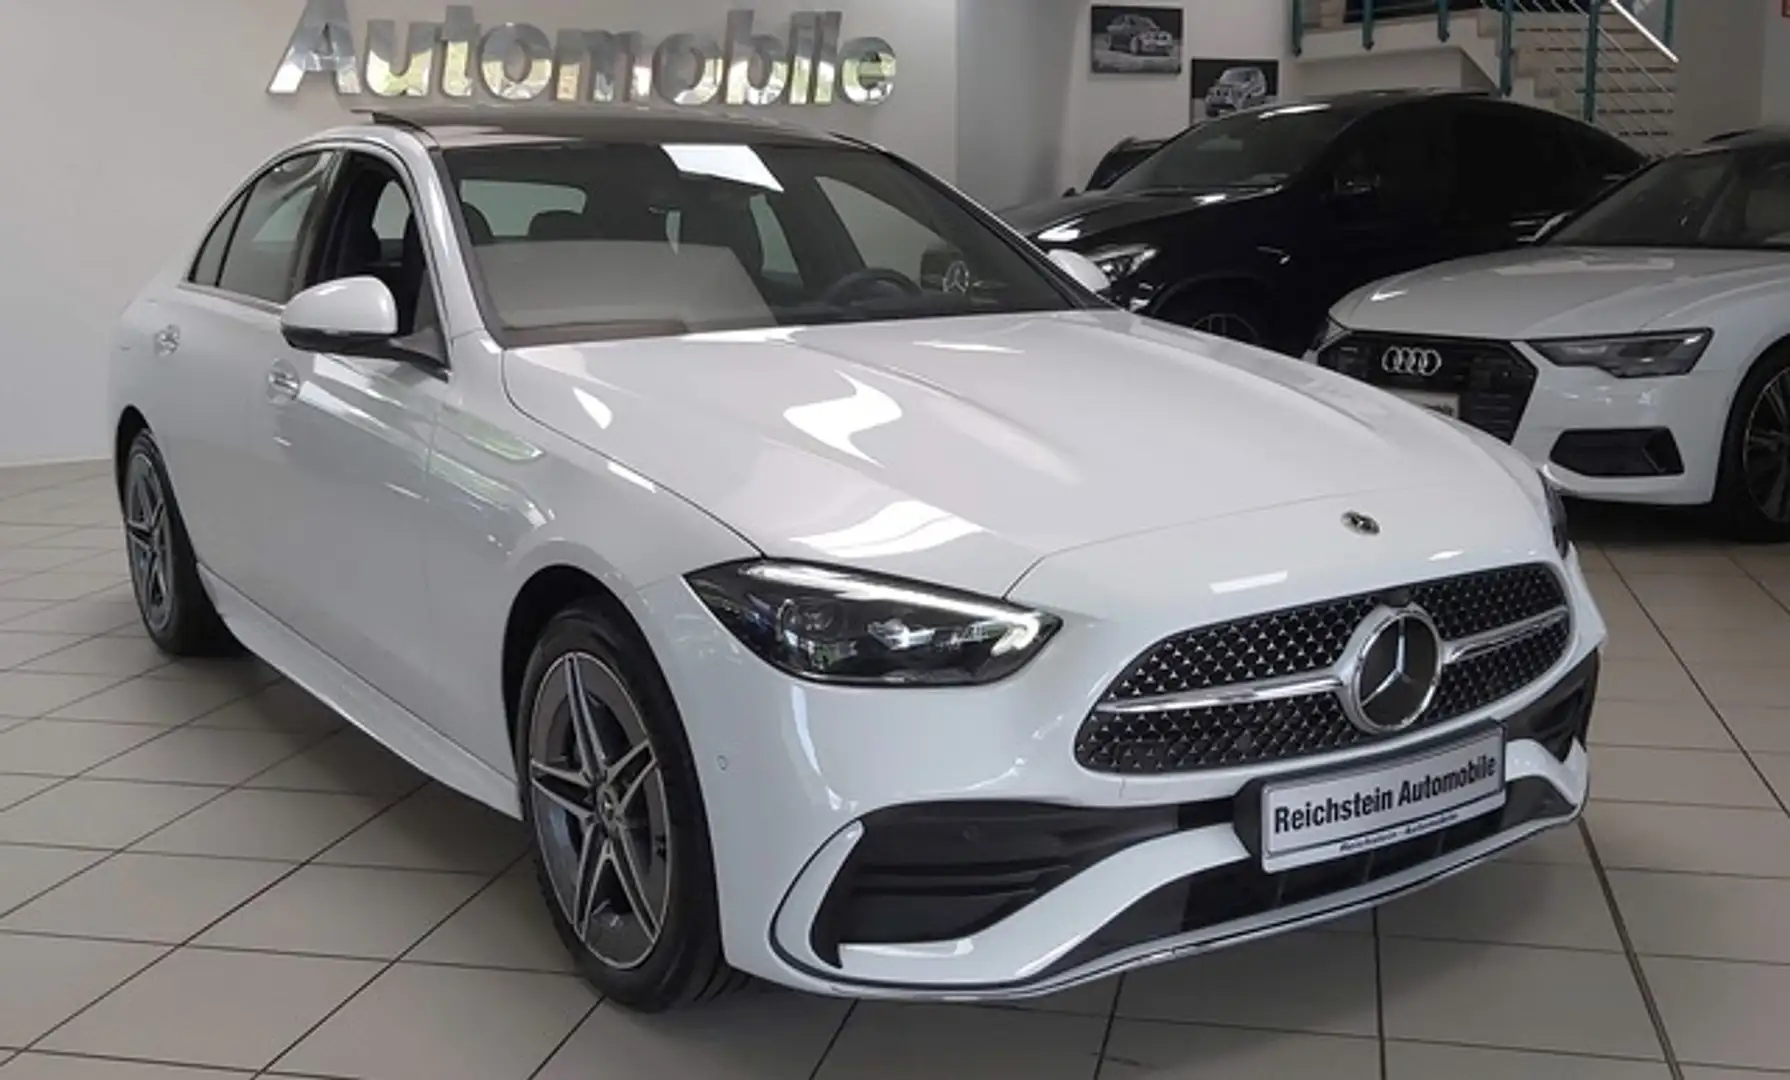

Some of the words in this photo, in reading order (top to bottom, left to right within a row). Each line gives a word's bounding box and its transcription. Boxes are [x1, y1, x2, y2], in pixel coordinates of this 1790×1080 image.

[266, 0, 897, 106] Automobile
[1275, 788, 1393, 833] Reichstein
[1399, 755, 1496, 805] Automobile
